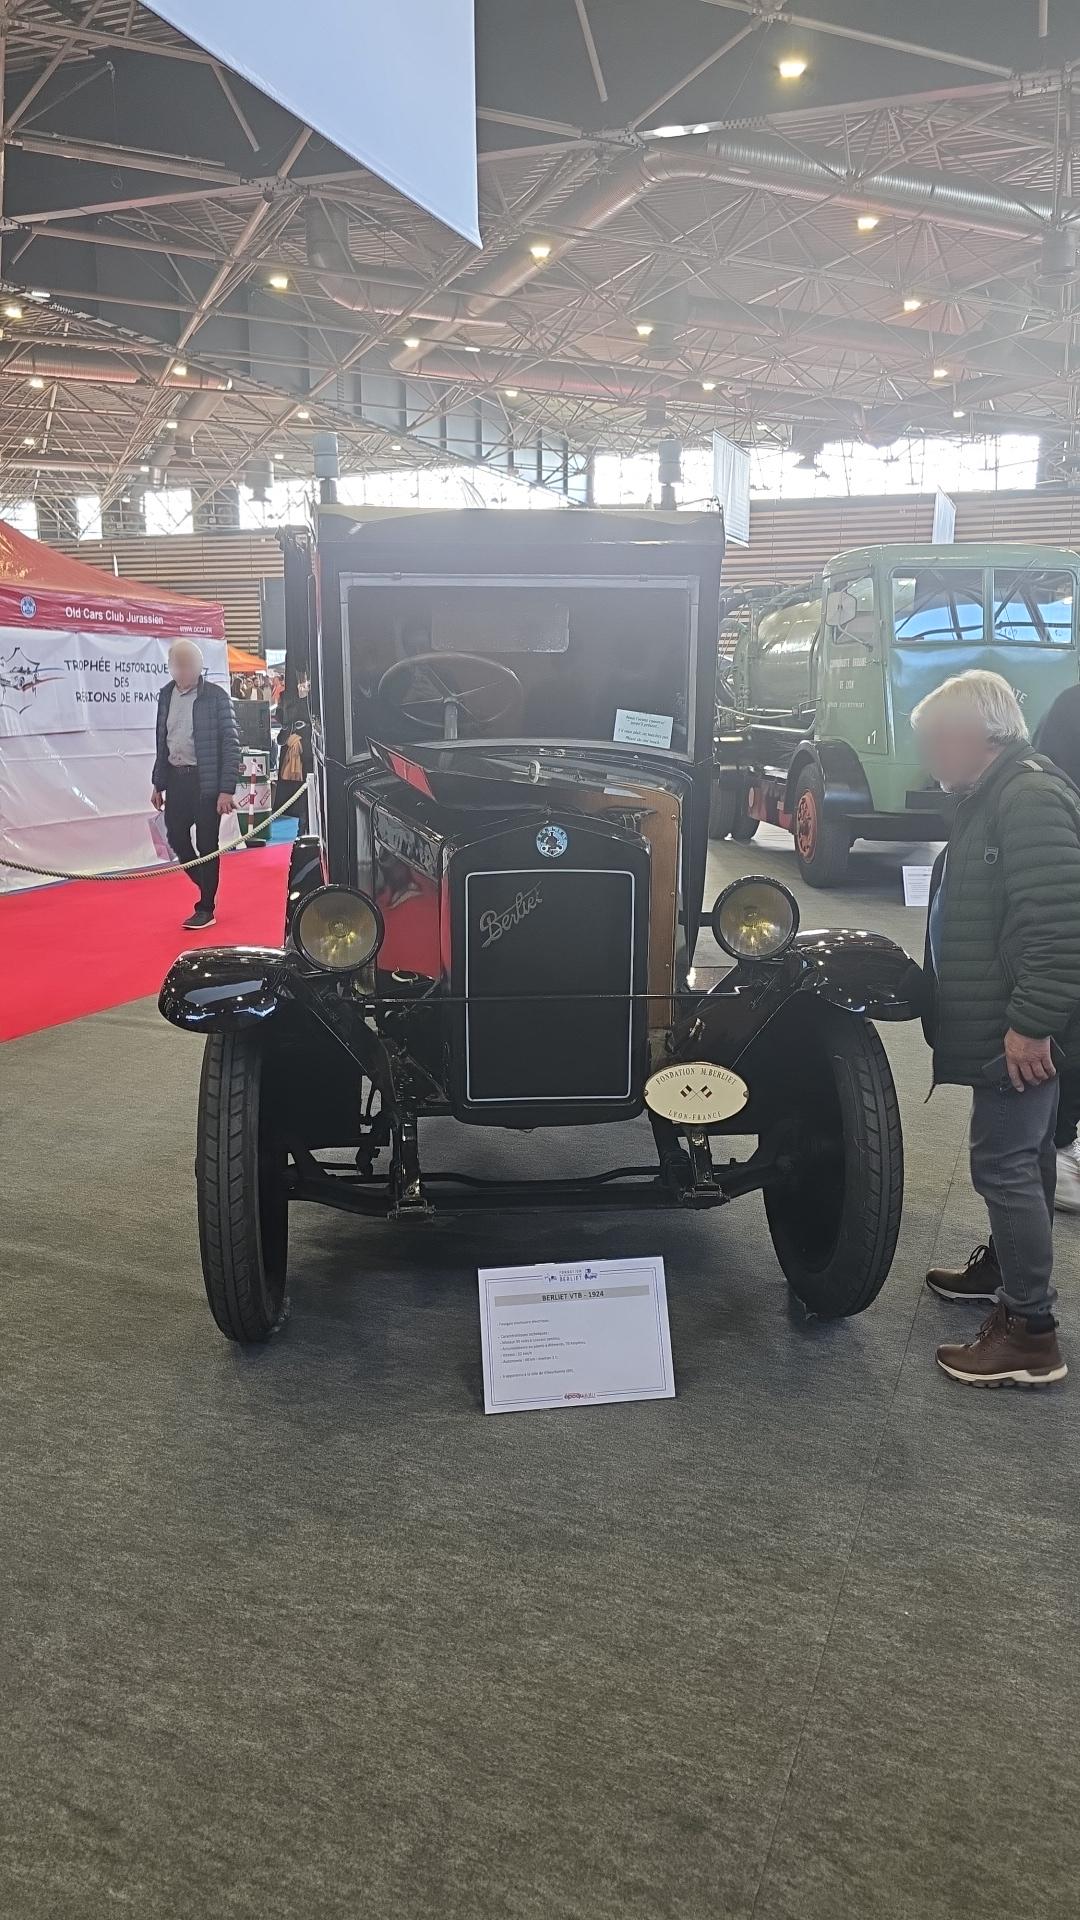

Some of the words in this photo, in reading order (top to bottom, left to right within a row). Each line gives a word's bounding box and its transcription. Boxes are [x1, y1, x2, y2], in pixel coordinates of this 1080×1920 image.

[65, 606, 81, 618] Old
[83, 608, 103, 621] Cars
[105, 611, 124, 623] Club
[126, 612, 164, 625] Jurassien
[64, 656, 111, 672] TROPHÉE
[115, 661, 169, 676] HISTORIQUE
[114, 676, 130, 688] DES
[75, 688, 117, 703] RÉGIONS
[121, 692, 131, 703] DE
[480, 881, 543, 948] Berliet
[655, 1067, 696, 1085] FONDATION
[701, 1067, 738, 1086] M.BERLIET
[542, 1293, 568, 1302] BERLIET
[569, 1292, 583, 1300] VTB
[588, 1290, 604, 1298] 1924
